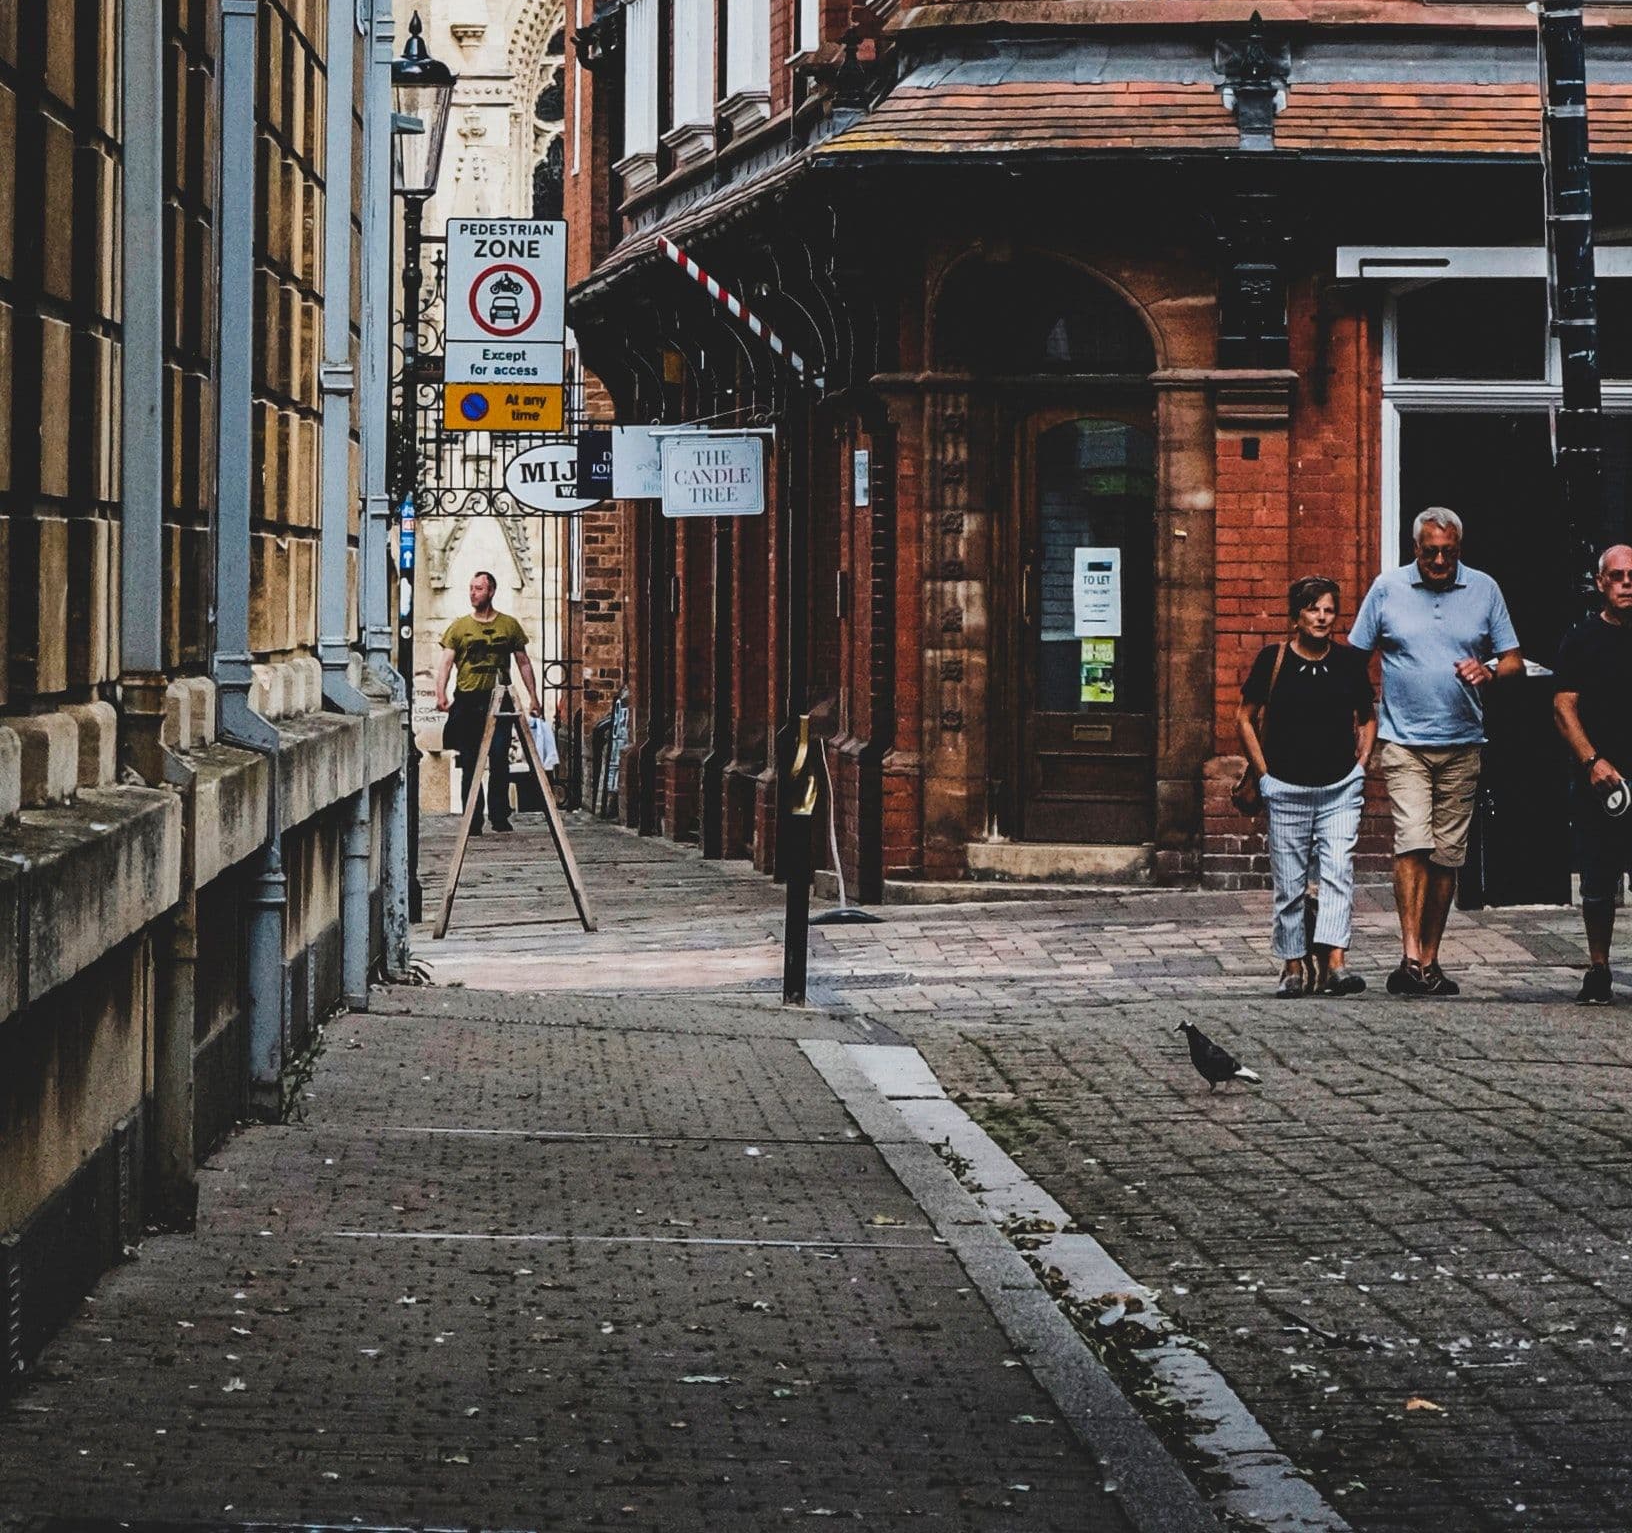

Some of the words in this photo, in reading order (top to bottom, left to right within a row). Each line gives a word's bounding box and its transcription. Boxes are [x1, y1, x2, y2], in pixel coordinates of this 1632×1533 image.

[459, 223, 554, 236] PEDESTRIAN
[474, 239, 540, 259] ZONE
[482, 349, 527, 363] Except
[470, 363, 488, 376] for
[494, 365, 538, 376] access
[505, 394, 519, 405] At
[523, 395, 547, 409] any
[511, 408, 541, 421] time
[692, 449, 732, 466] THE
[674, 467, 751, 485] CANDLE
[688, 486, 738, 504] TREE
[1083, 575, 1095, 585] TO
[1097, 575, 1110, 585] LET
